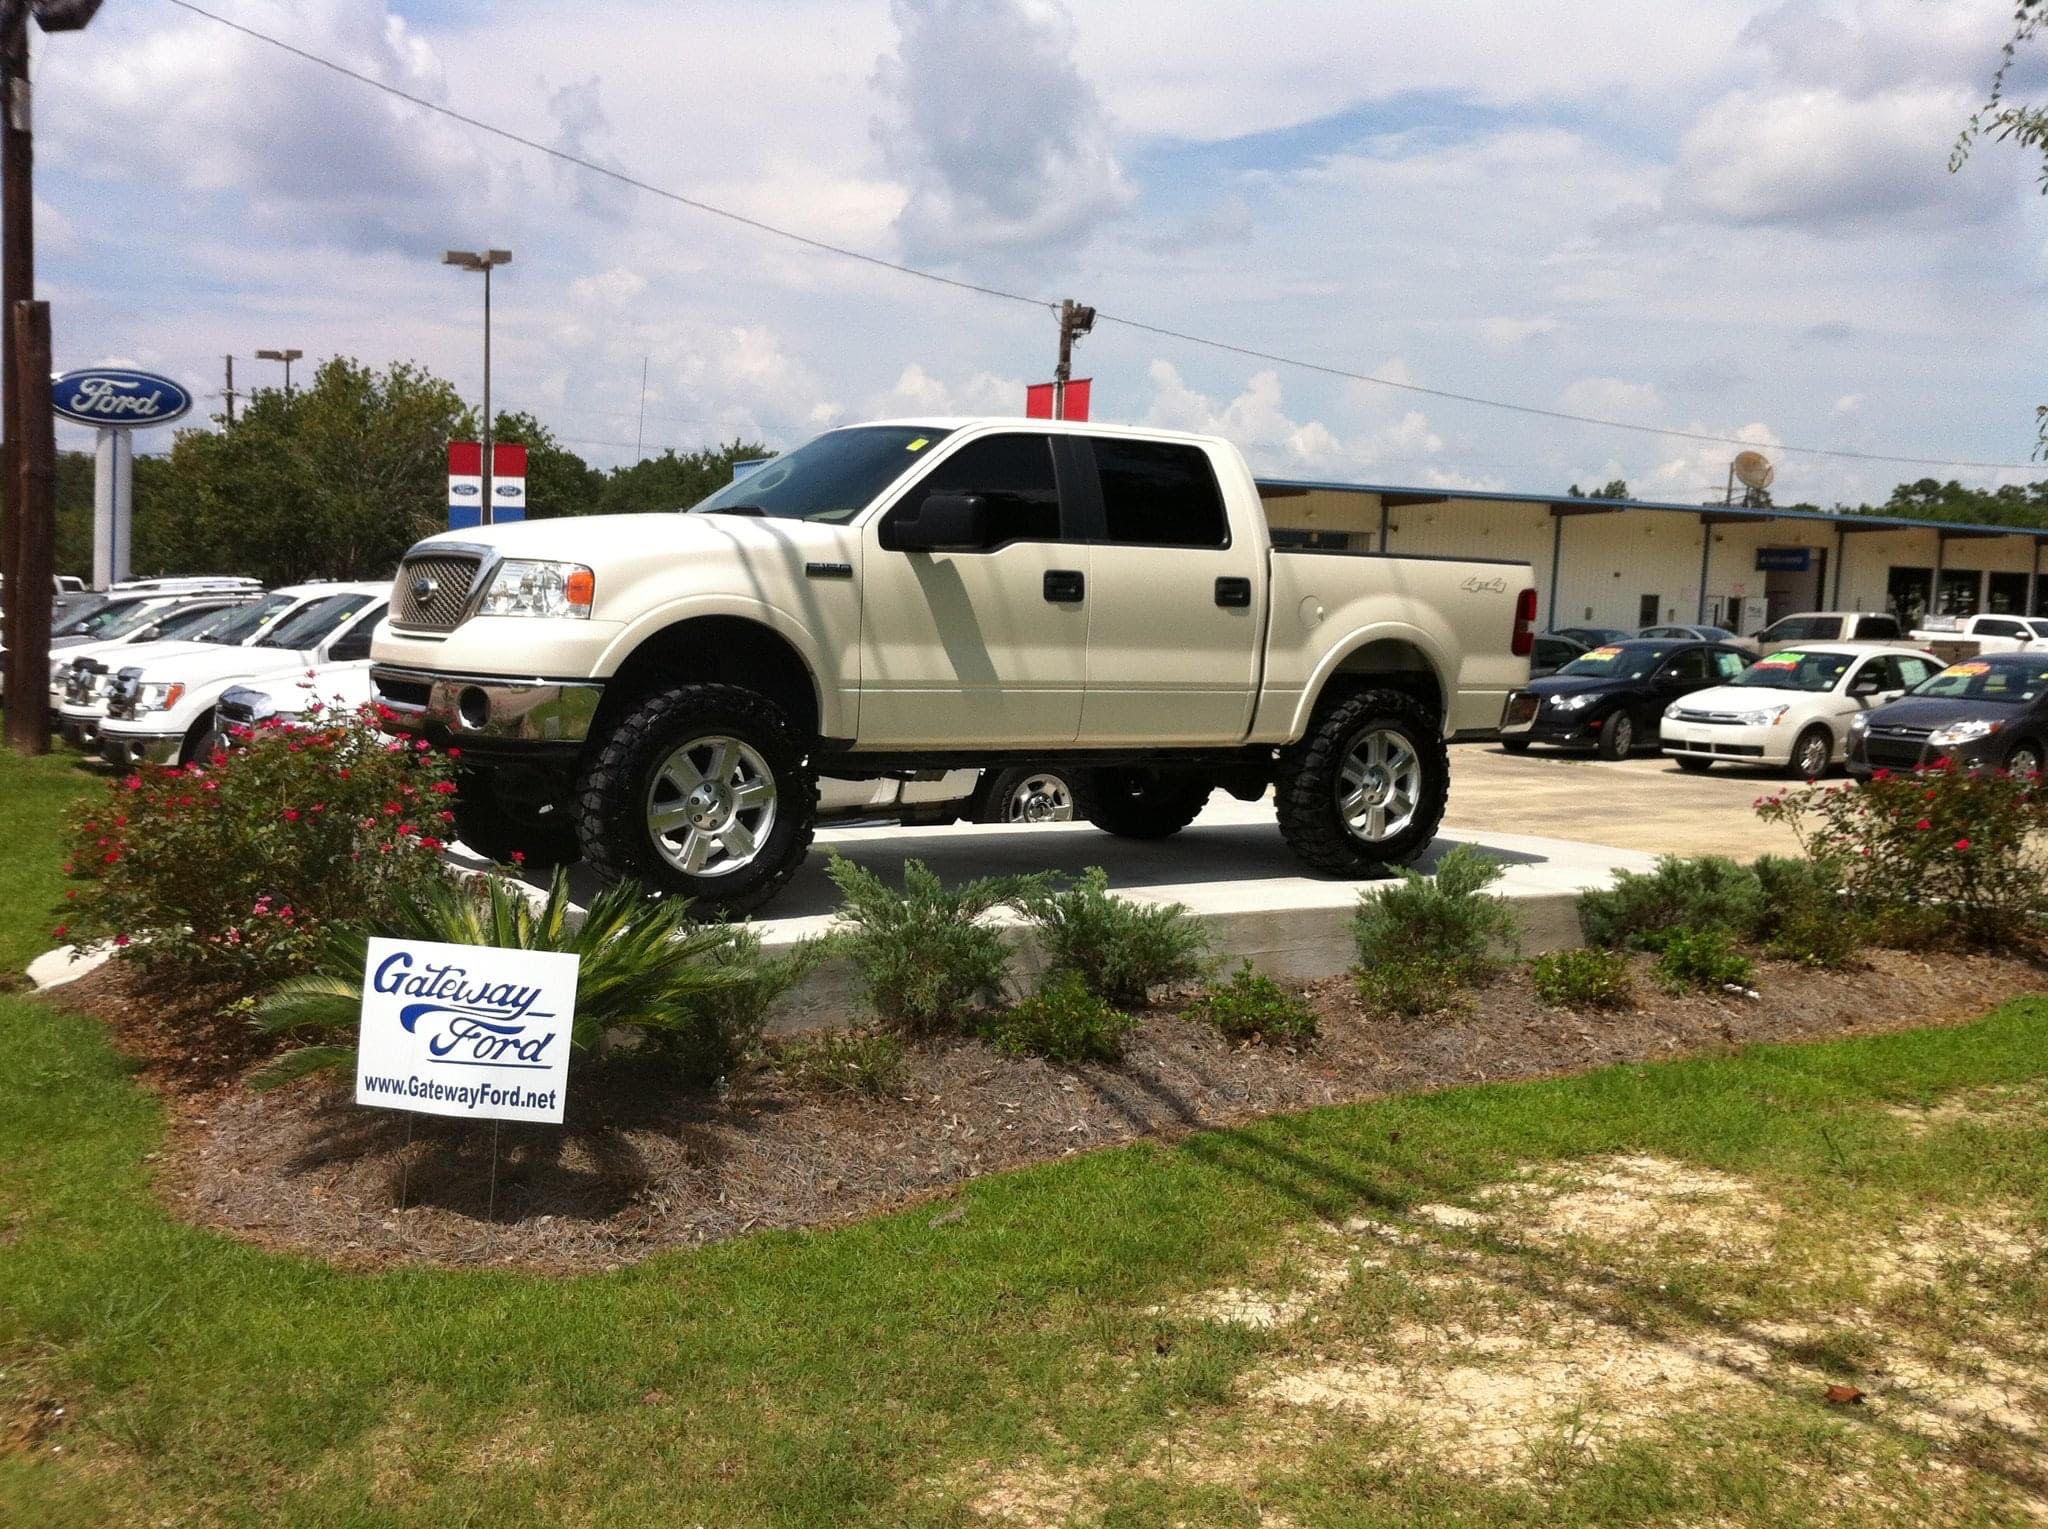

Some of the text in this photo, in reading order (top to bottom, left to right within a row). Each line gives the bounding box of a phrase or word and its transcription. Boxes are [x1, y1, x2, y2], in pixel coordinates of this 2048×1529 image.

[70, 378, 162, 415] Ford
[374, 952, 542, 1019] Gateway
[429, 1016, 556, 1063] Ford
[364, 1075, 556, 1110] www.GatewayFord.net
